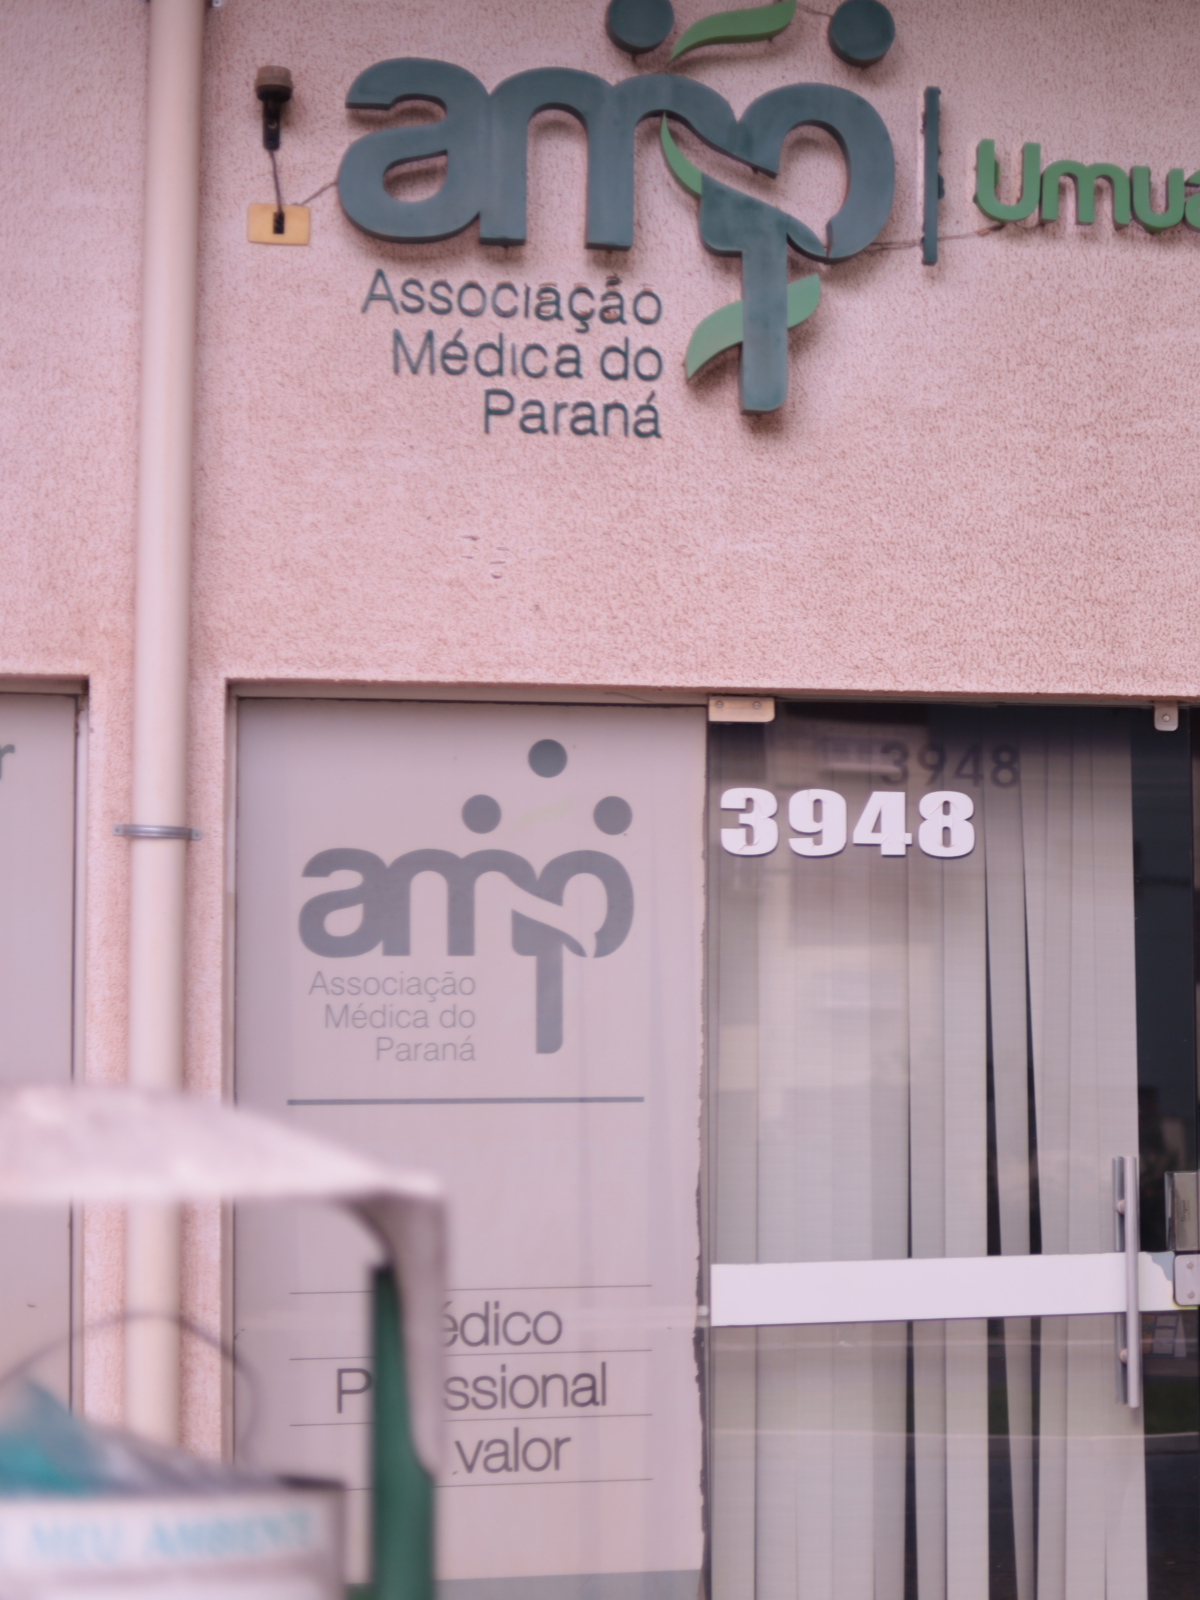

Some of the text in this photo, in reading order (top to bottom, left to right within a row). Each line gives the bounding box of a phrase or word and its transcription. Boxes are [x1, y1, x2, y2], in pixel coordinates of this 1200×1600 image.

[361, 268, 663, 333] Associação
[392, 327, 663, 381] Médica do
[484, 389, 662, 439] Paraná
[719, 787, 976, 858] 3948
[308, 970, 476, 1003] Associação
[325, 1003, 476, 1029] Médica do
[375, 1035, 476, 1062] Paraná
[442, 1300, 563, 1347] édico
[455, 1427, 571, 1473] valor
